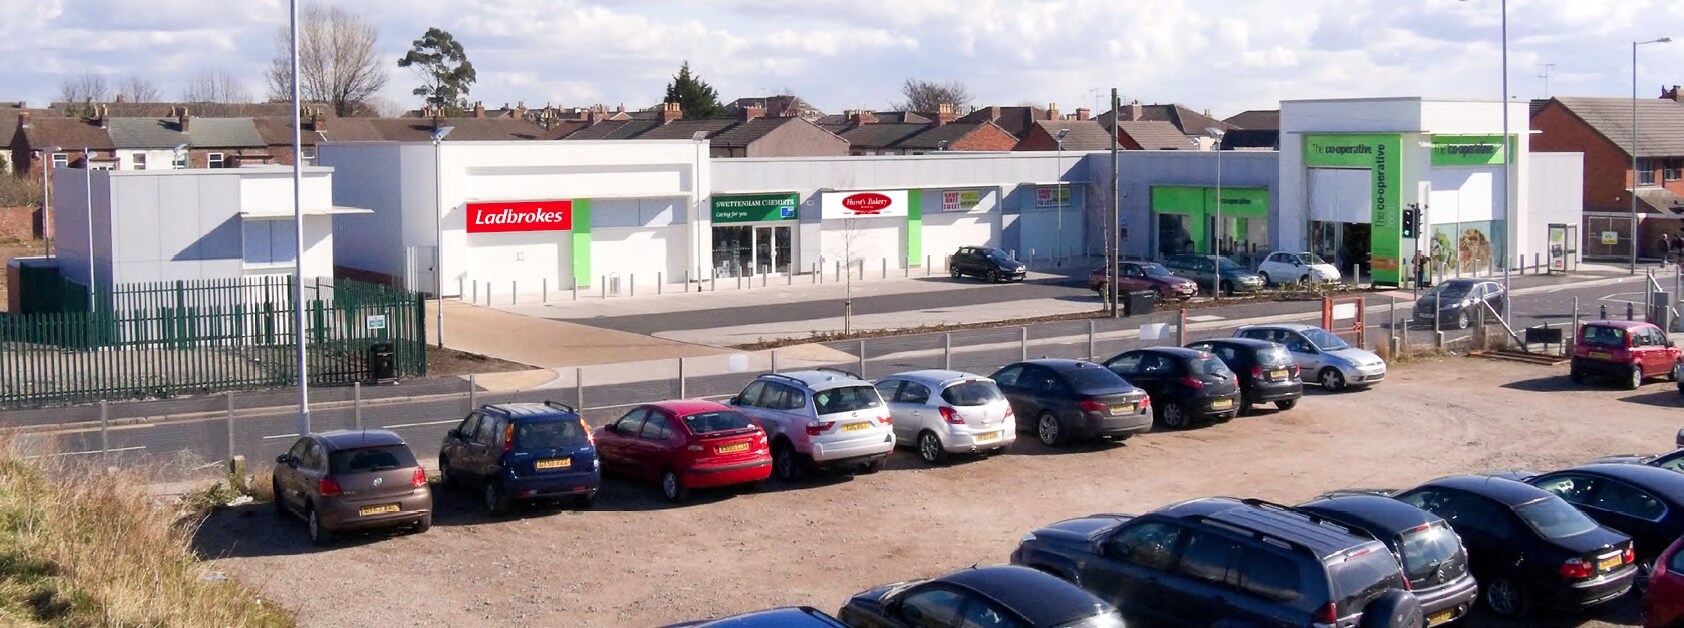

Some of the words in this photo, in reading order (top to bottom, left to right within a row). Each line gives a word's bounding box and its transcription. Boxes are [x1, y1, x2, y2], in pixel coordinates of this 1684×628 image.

[1312, 143, 1324, 154] The
[1325, 144, 1372, 155] co-operative
[1375, 144, 1386, 211] co-operative
[716, 199, 761, 207] SWETTENHAM
[846, 198, 867, 206] Hurst's
[867, 197, 888, 206] Bakery
[475, 207, 563, 225] Ladbrokes
